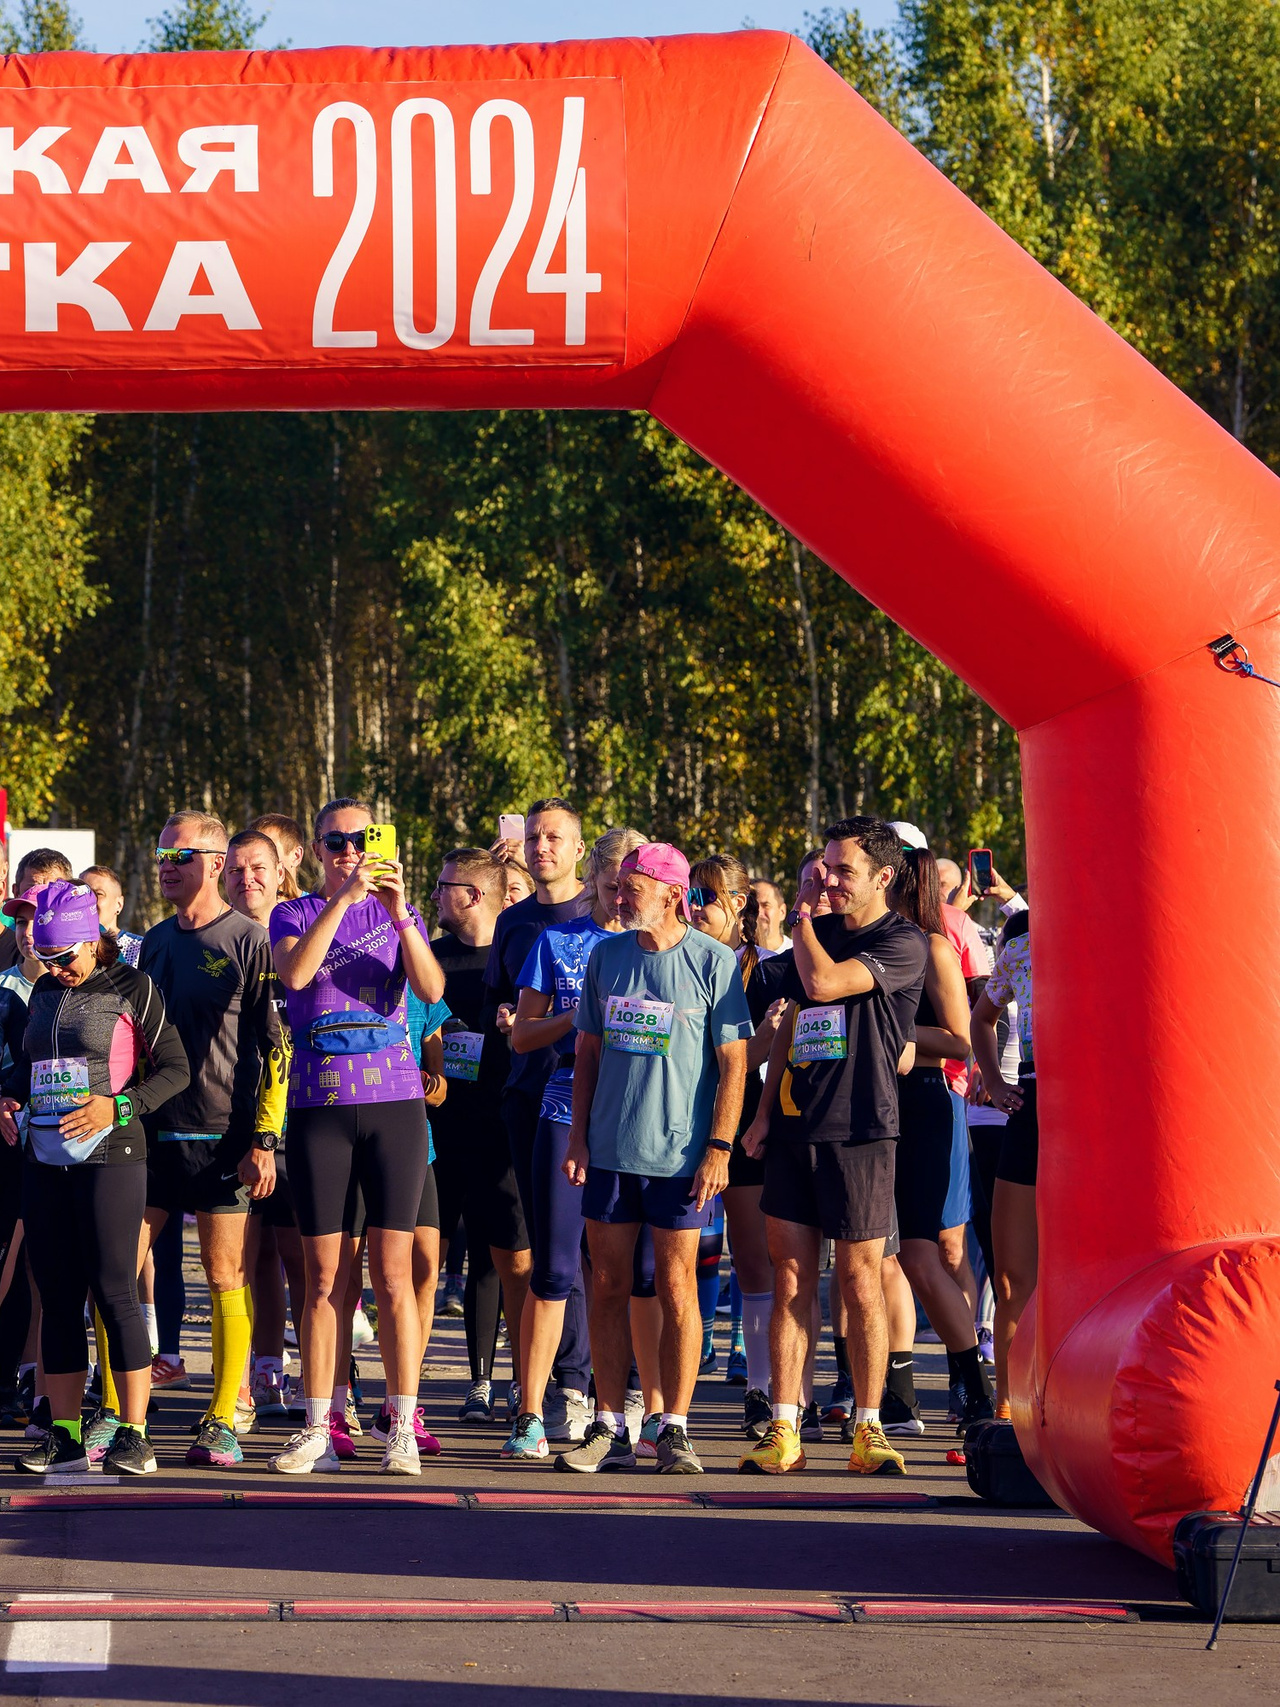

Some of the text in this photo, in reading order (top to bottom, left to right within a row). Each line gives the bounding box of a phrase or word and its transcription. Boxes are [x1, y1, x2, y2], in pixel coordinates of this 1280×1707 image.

[311, 96, 602, 351] 2024
[318, 935, 388, 976] TRAIL 2020
[616, 1010, 658, 1026] 1028
[800, 1020, 832, 1034] 1049
[40, 1071, 72, 1085] 1016
